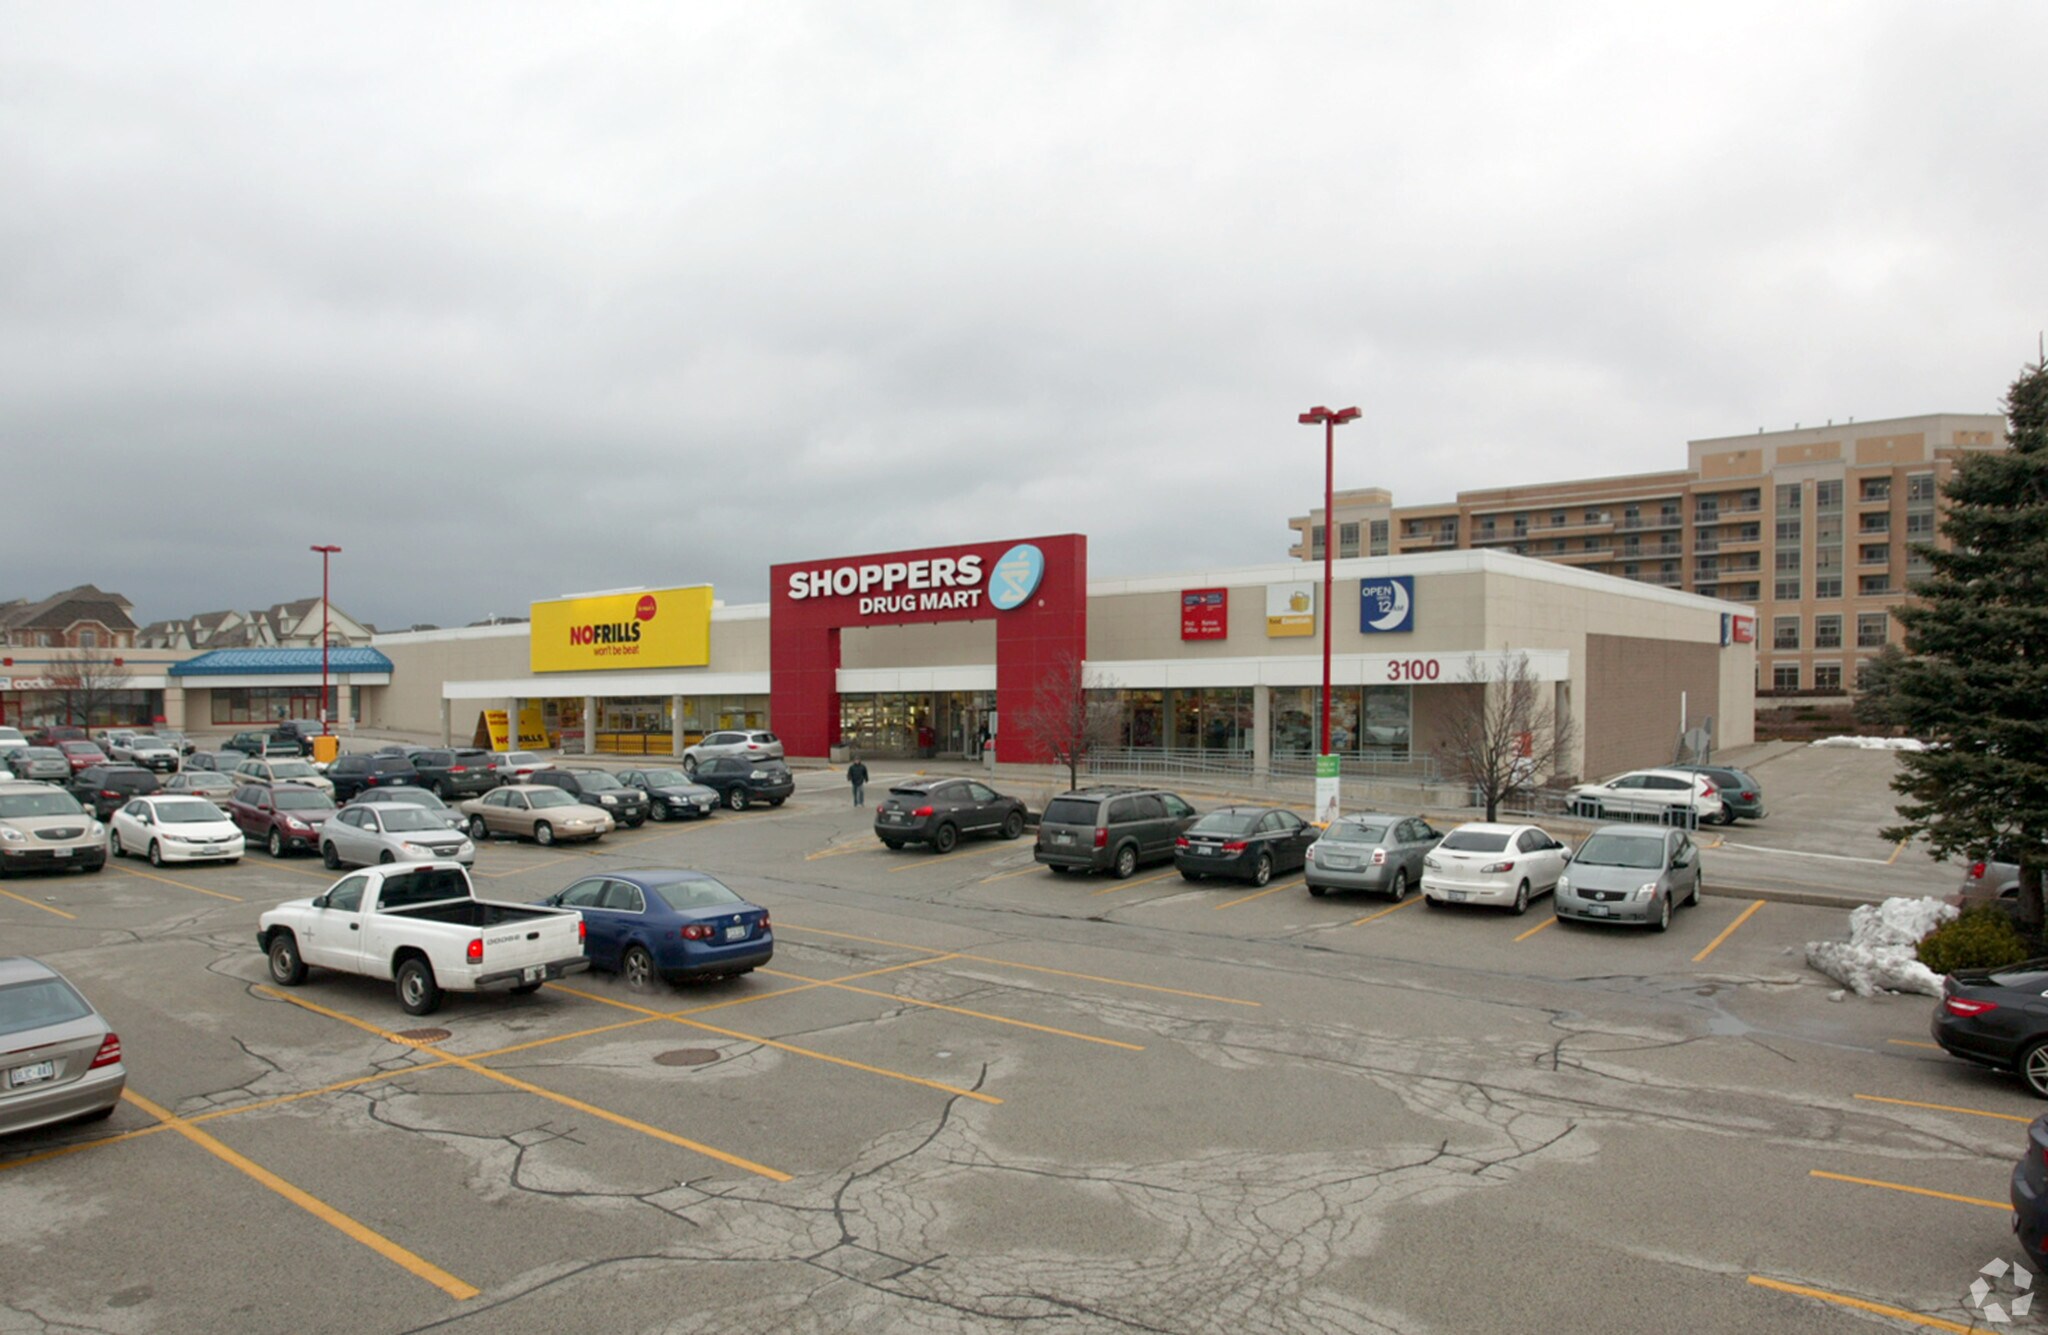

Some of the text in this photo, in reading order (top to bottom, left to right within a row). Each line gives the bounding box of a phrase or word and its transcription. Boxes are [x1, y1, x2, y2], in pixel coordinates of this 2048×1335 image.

[788, 554, 983, 600] SHOPPERS
[1362, 586, 1392, 597] OPEN
[859, 589, 982, 615] DRUG MART
[1377, 601, 1392, 613] 12
[612, 645, 622, 656] be
[622, 644, 640, 655] beat
[1387, 658, 1440, 681] 3100
